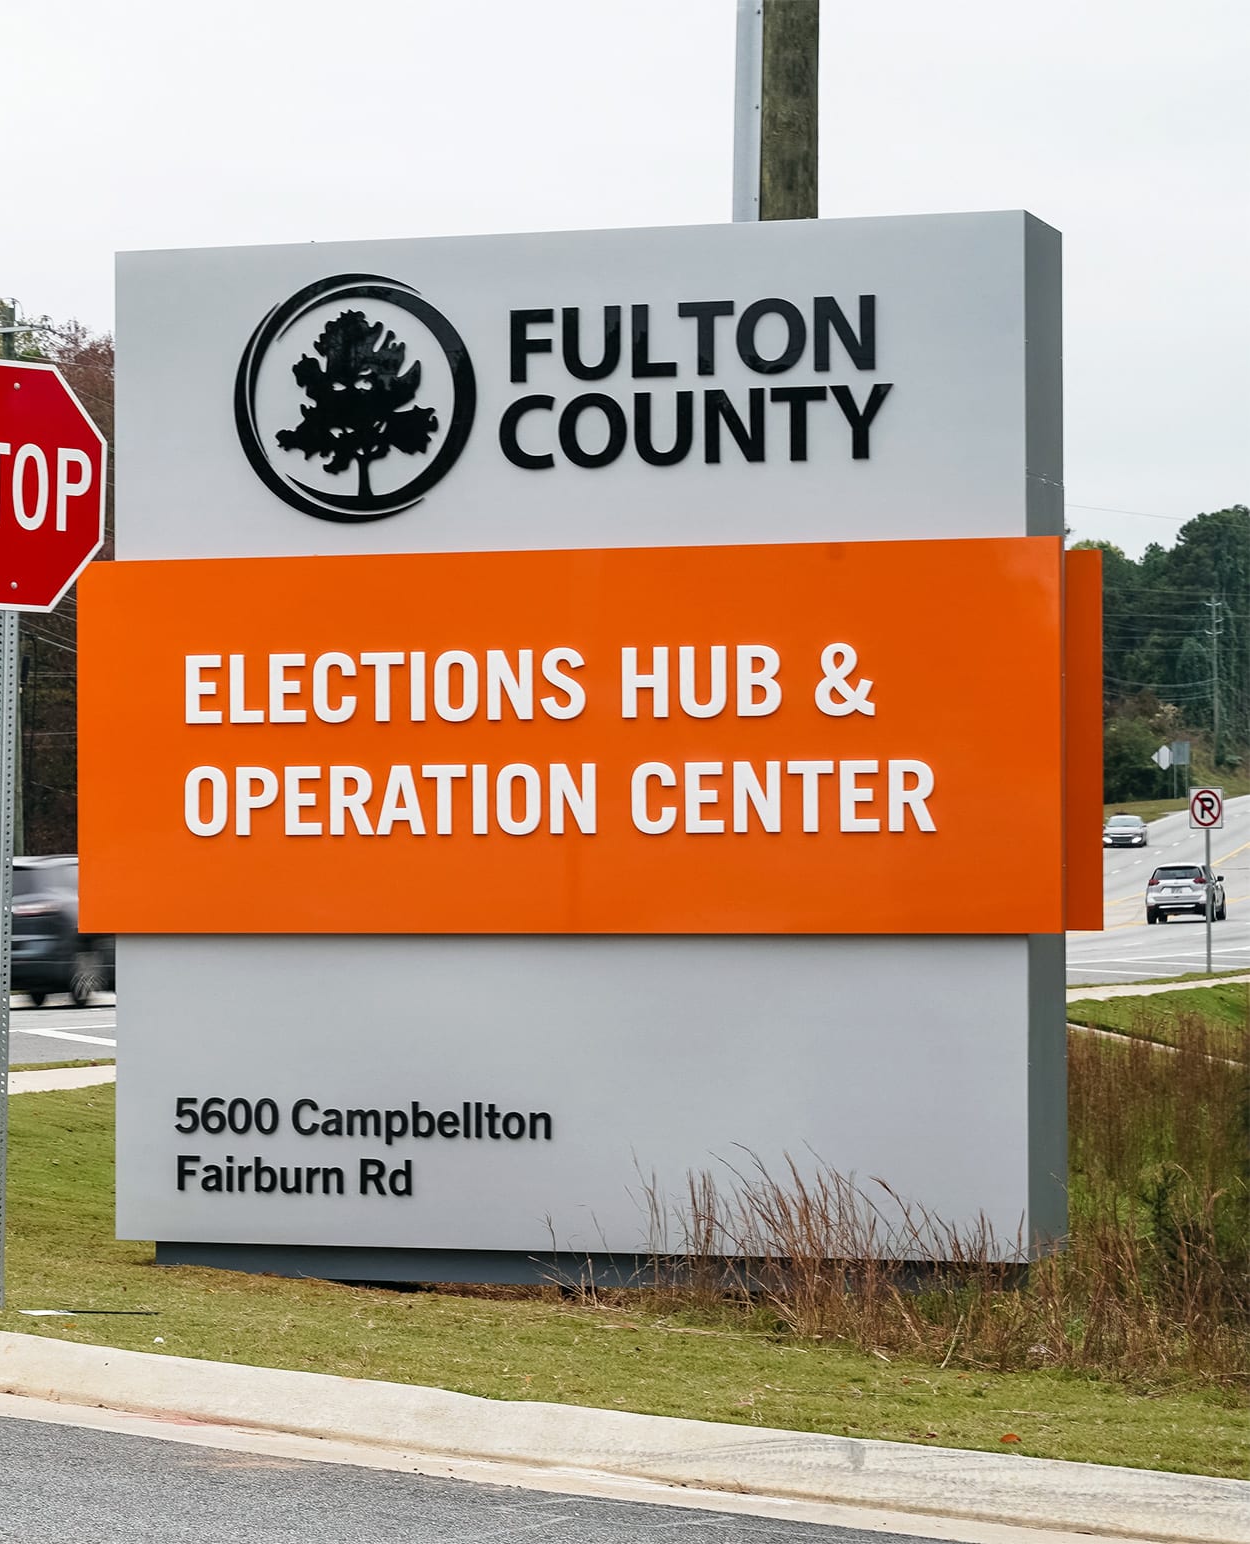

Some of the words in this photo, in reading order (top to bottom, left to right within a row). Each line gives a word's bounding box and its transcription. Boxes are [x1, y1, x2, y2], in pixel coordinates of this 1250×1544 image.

[509, 294, 877, 384] FULTON
[498, 383, 894, 471] COUNTY
[185, 647, 587, 724] ELECTIONS
[621, 644, 782, 719] HUB
[814, 642, 876, 717] &
[184, 762, 597, 837] OPERATION
[631, 759, 937, 835] CENTER
[174, 1097, 280, 1136] 5600
[291, 1098, 553, 1146] Campbellton
[176, 1154, 345, 1196] Fairburn
[359, 1158, 414, 1197] Rd
